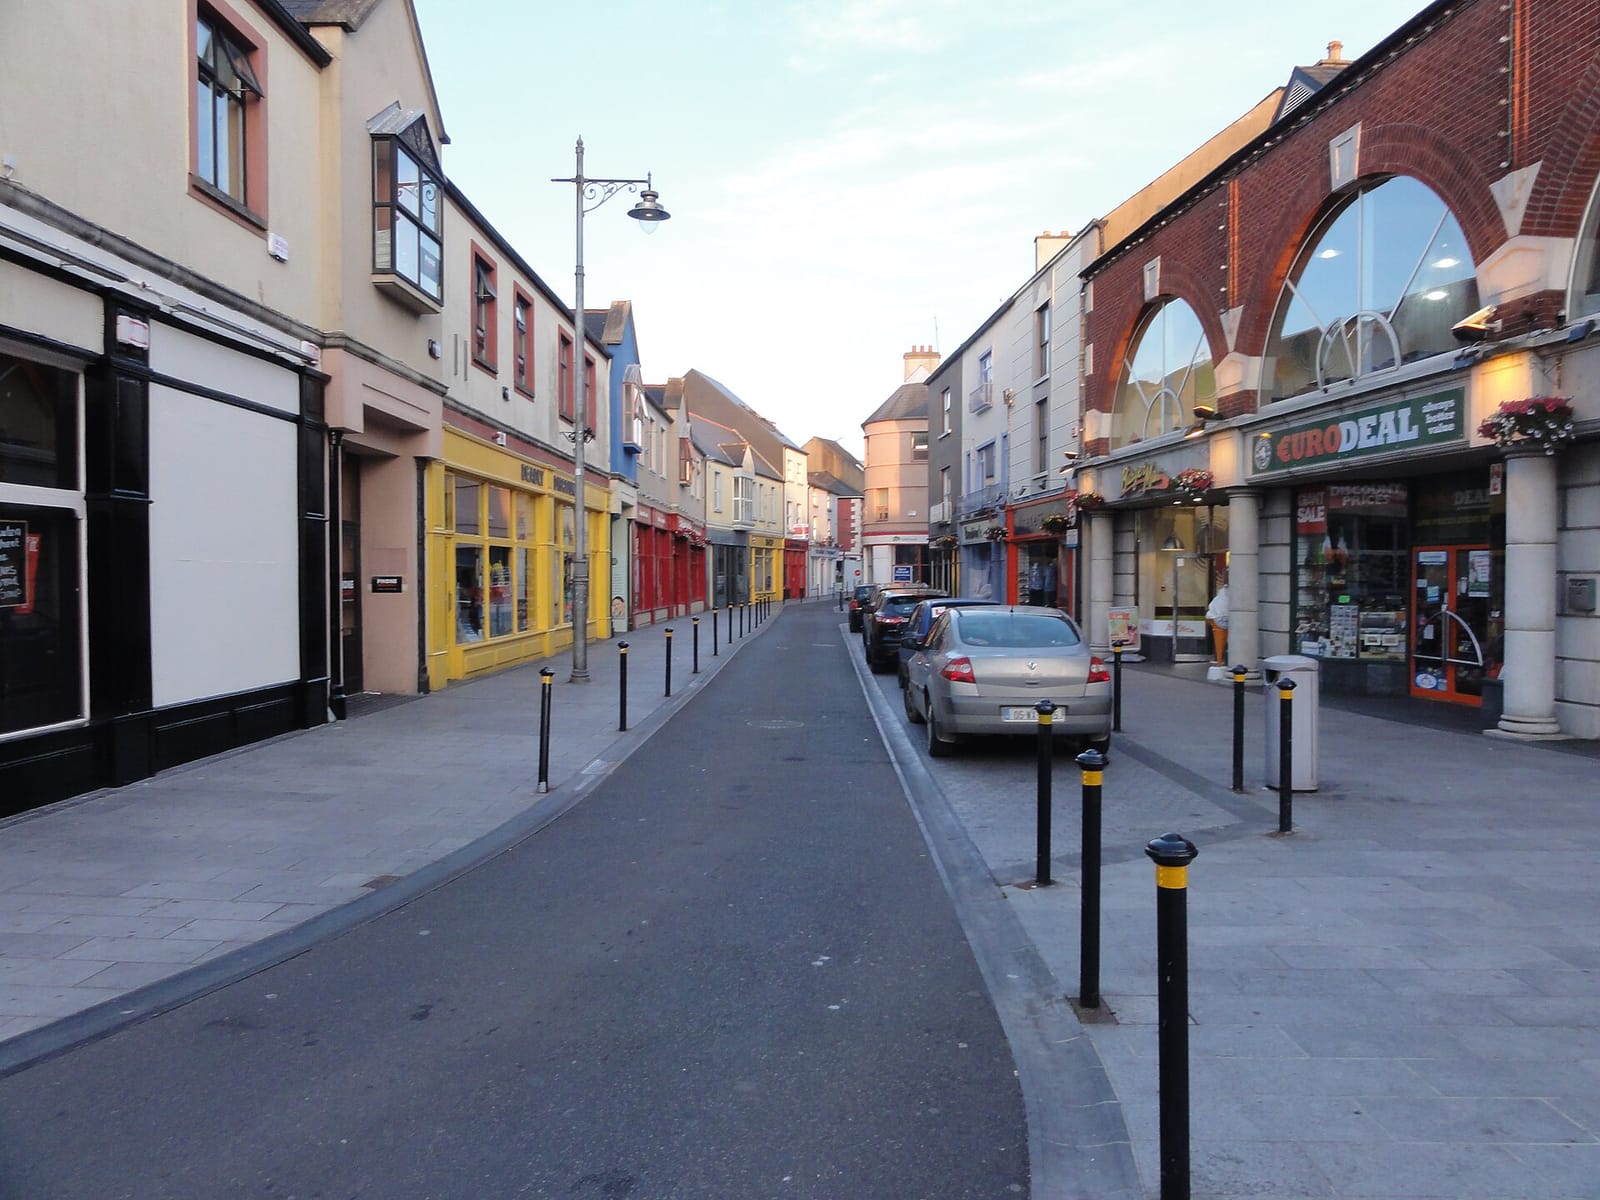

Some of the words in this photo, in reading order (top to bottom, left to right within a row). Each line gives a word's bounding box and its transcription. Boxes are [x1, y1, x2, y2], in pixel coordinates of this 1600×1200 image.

[1422, 399, 1456, 413] always
[1425, 411, 1456, 424] better
[1427, 422, 1456, 435] value
[1342, 494, 1390, 506] PRICES
[1297, 505, 1325, 523] SALE
